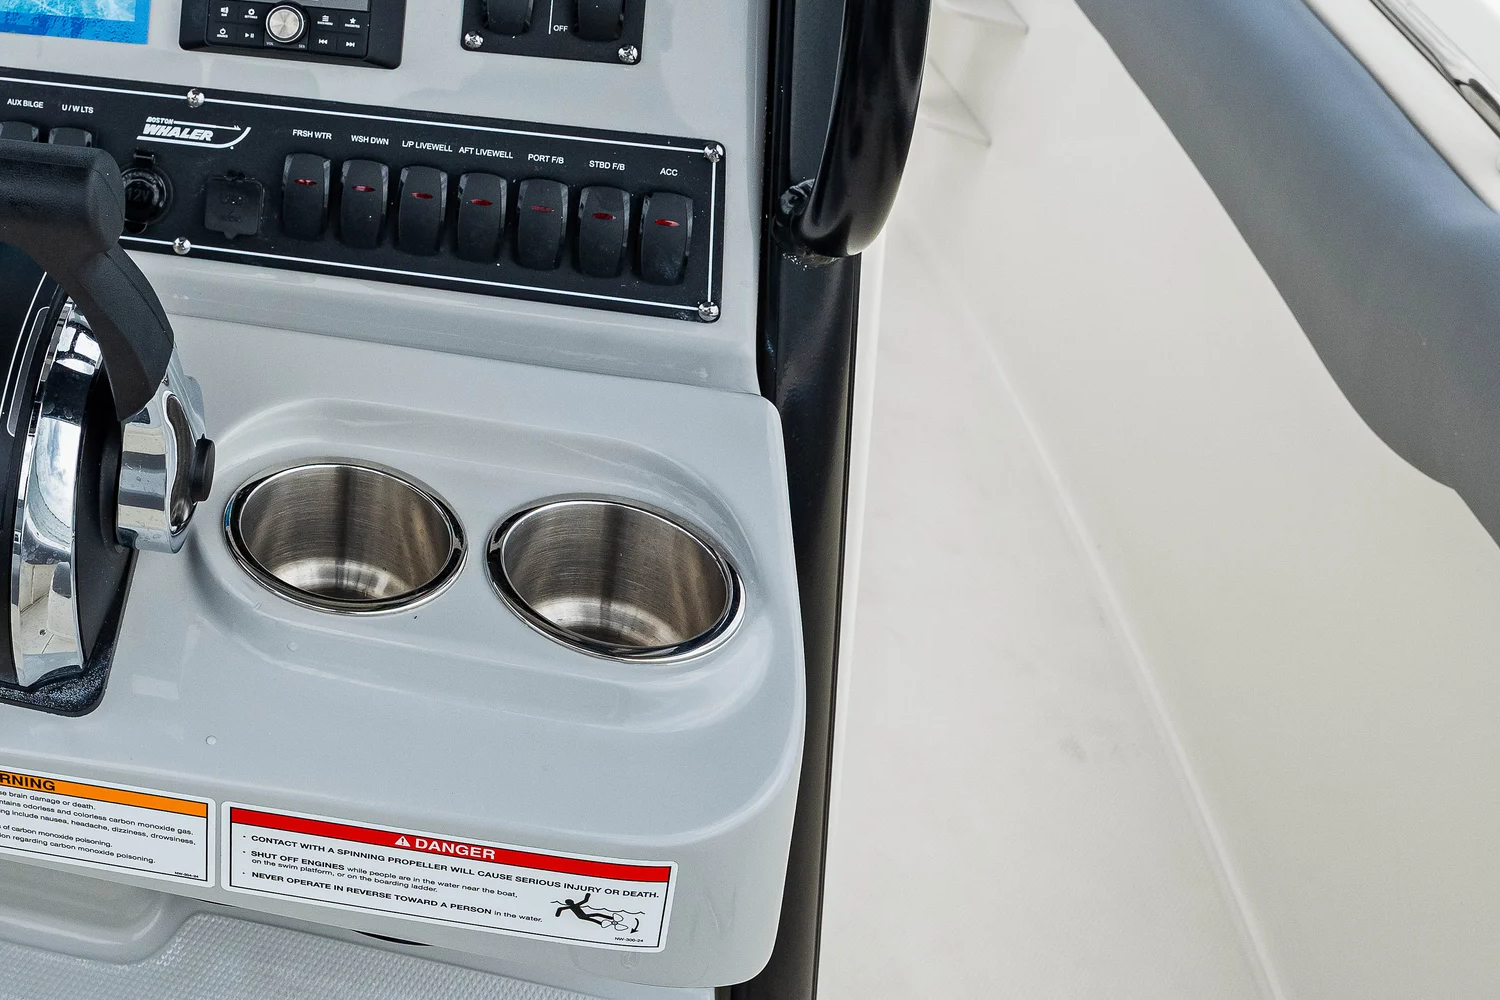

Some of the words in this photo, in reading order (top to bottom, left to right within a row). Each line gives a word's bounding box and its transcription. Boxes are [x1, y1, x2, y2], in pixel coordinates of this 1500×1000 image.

[7, 98, 22, 107] AUX
[23, 99, 44, 109] BILGE
[80, 105, 94, 114] LTS
[146, 116, 174, 124] BOSTON
[142, 123, 214, 142] WHALER
[293, 129, 313, 138] FRSH
[314, 131, 332, 140] WTR
[351, 135, 369, 143] WSH
[370, 137, 389, 145] DWN
[402, 140, 414, 148] L/P
[415, 142, 453, 152] LIVEWELL
[459, 146, 474, 155] AFT
[476, 148, 513, 159] LIVEWELL
[528, 154, 550, 163] PORT
[552, 155, 564, 164] F/B
[589, 160, 610, 170] STBD
[612, 162, 625, 171] F/B
[660, 168, 678, 176] ACC
[9, 789, 28, 799] brain
[30, 795, 60, 805] damage
[72, 801, 96, 811] death.
[415, 838, 495, 860] DANGER
[251, 851, 277, 860] SHUT
[280, 855, 299, 863] OFF
[301, 859, 345, 870] ENGINES
[251, 835, 298, 848] CONTACT
[300, 843, 325, 852] WITH
[337, 848, 385, 862] SPINNING
[388, 857, 448, 871] PROPELLER
[450, 866, 475, 875] WILL
[478, 870, 513, 881] CAUSE
[515, 876, 561, 888] SERIOUS
[564, 882, 602, 894] INJURY
[622, 890, 659, 898] DEATH.
[252, 872, 284, 882] NEVER
[287, 878, 331, 890] OPERATE
[347, 887, 392, 900] REVERSE
[394, 894, 438, 907] TOWARD
[450, 903, 492, 915] PERSON
[504, 911, 517, 919] the
[519, 914, 543, 922] water.
